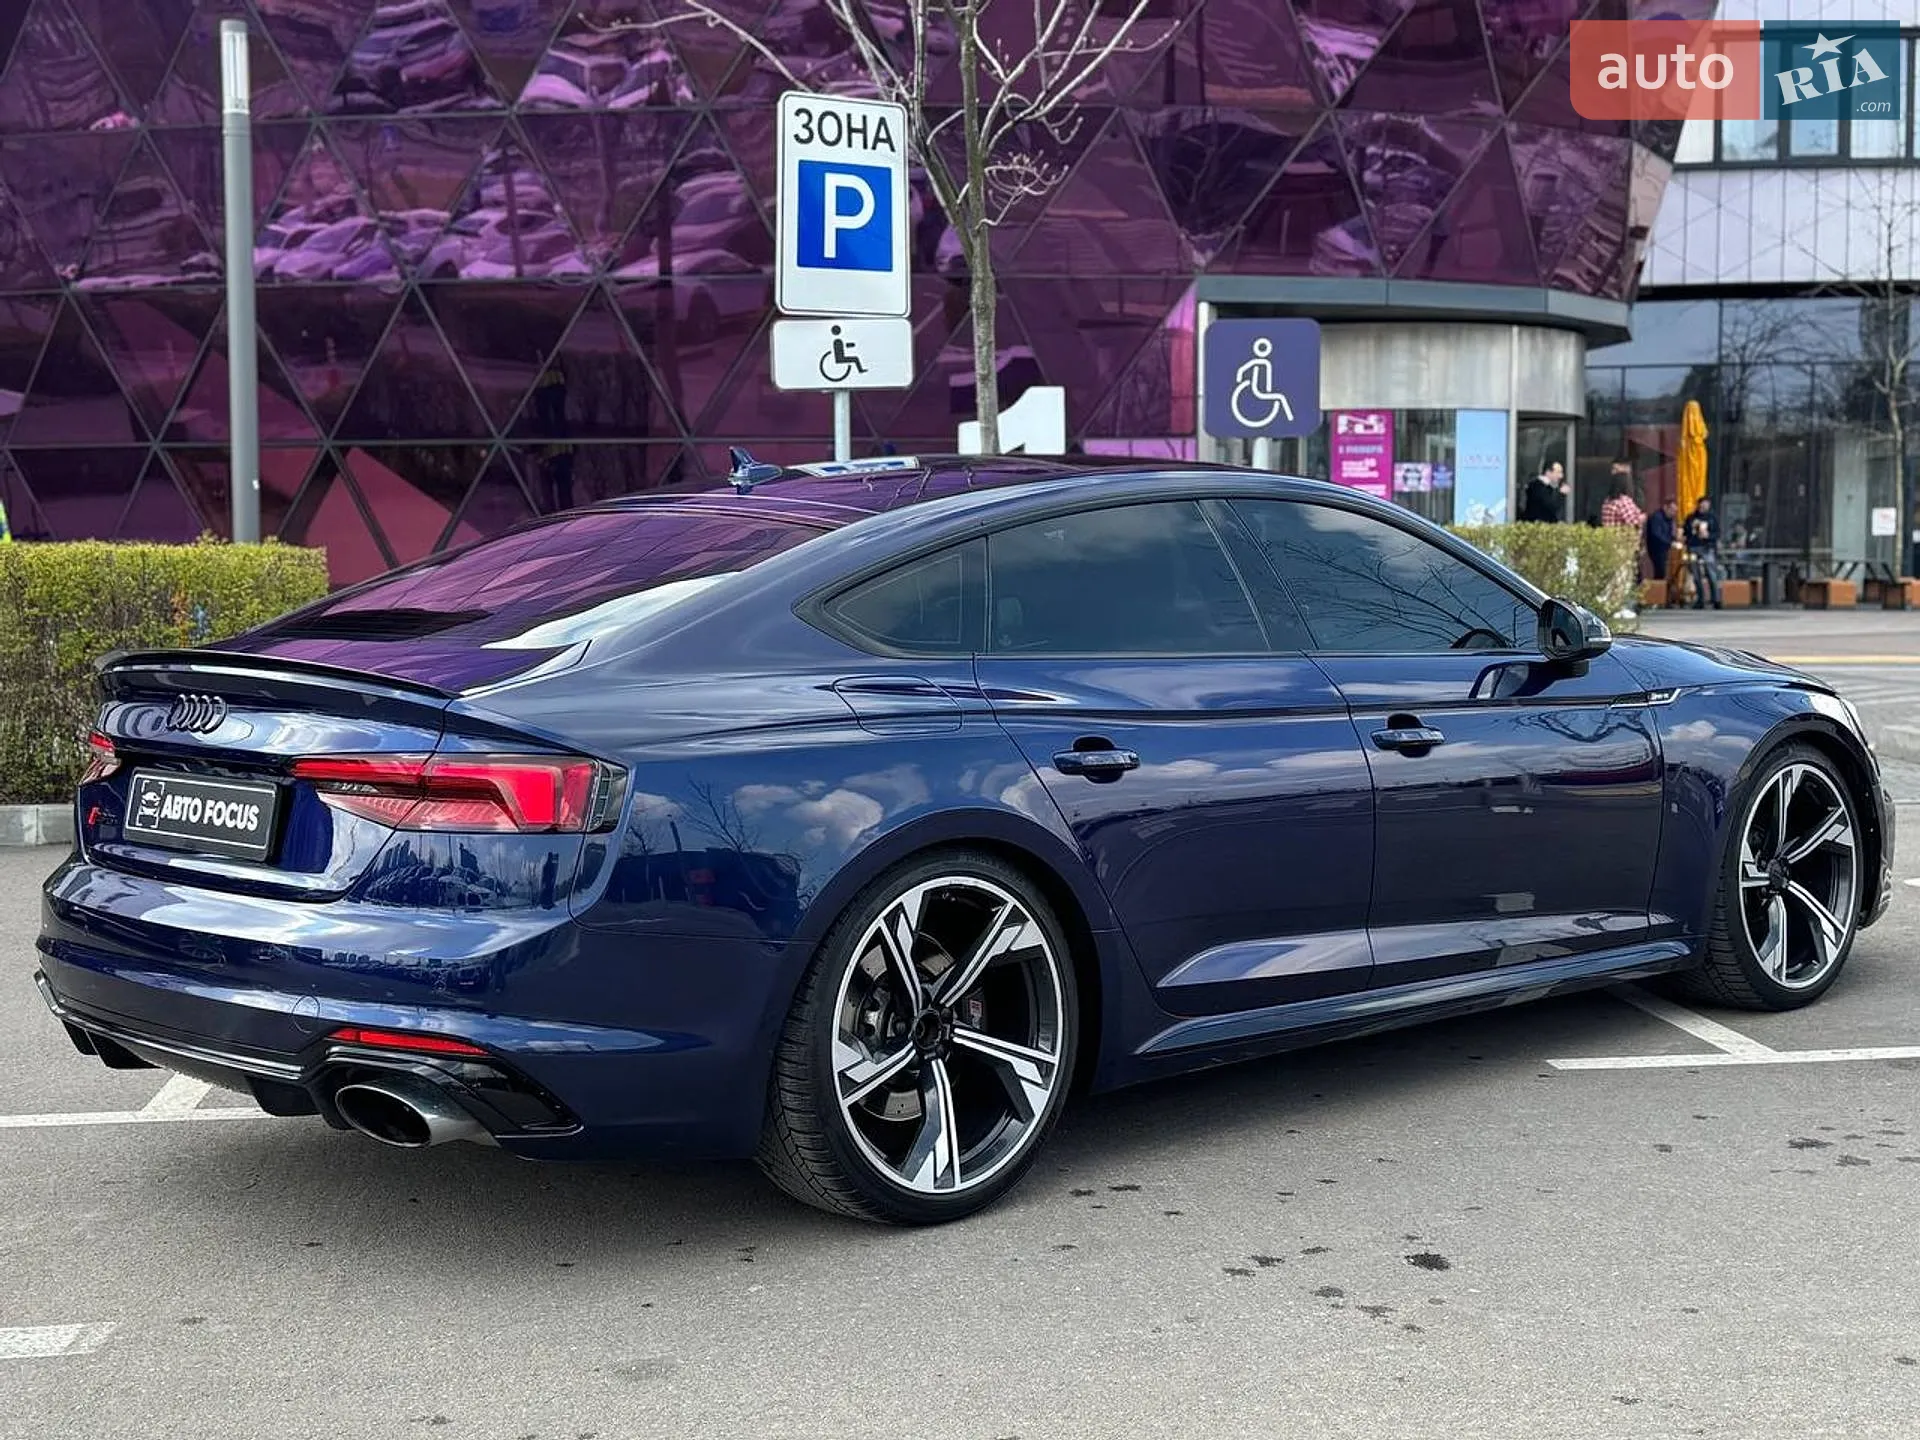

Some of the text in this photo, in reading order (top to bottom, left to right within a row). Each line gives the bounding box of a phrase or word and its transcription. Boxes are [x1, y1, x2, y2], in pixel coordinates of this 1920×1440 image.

[793, 107, 896, 153] ЗОНА
[823, 172, 876, 259] P
[160, 794, 260, 831] АВТО FOCUS
